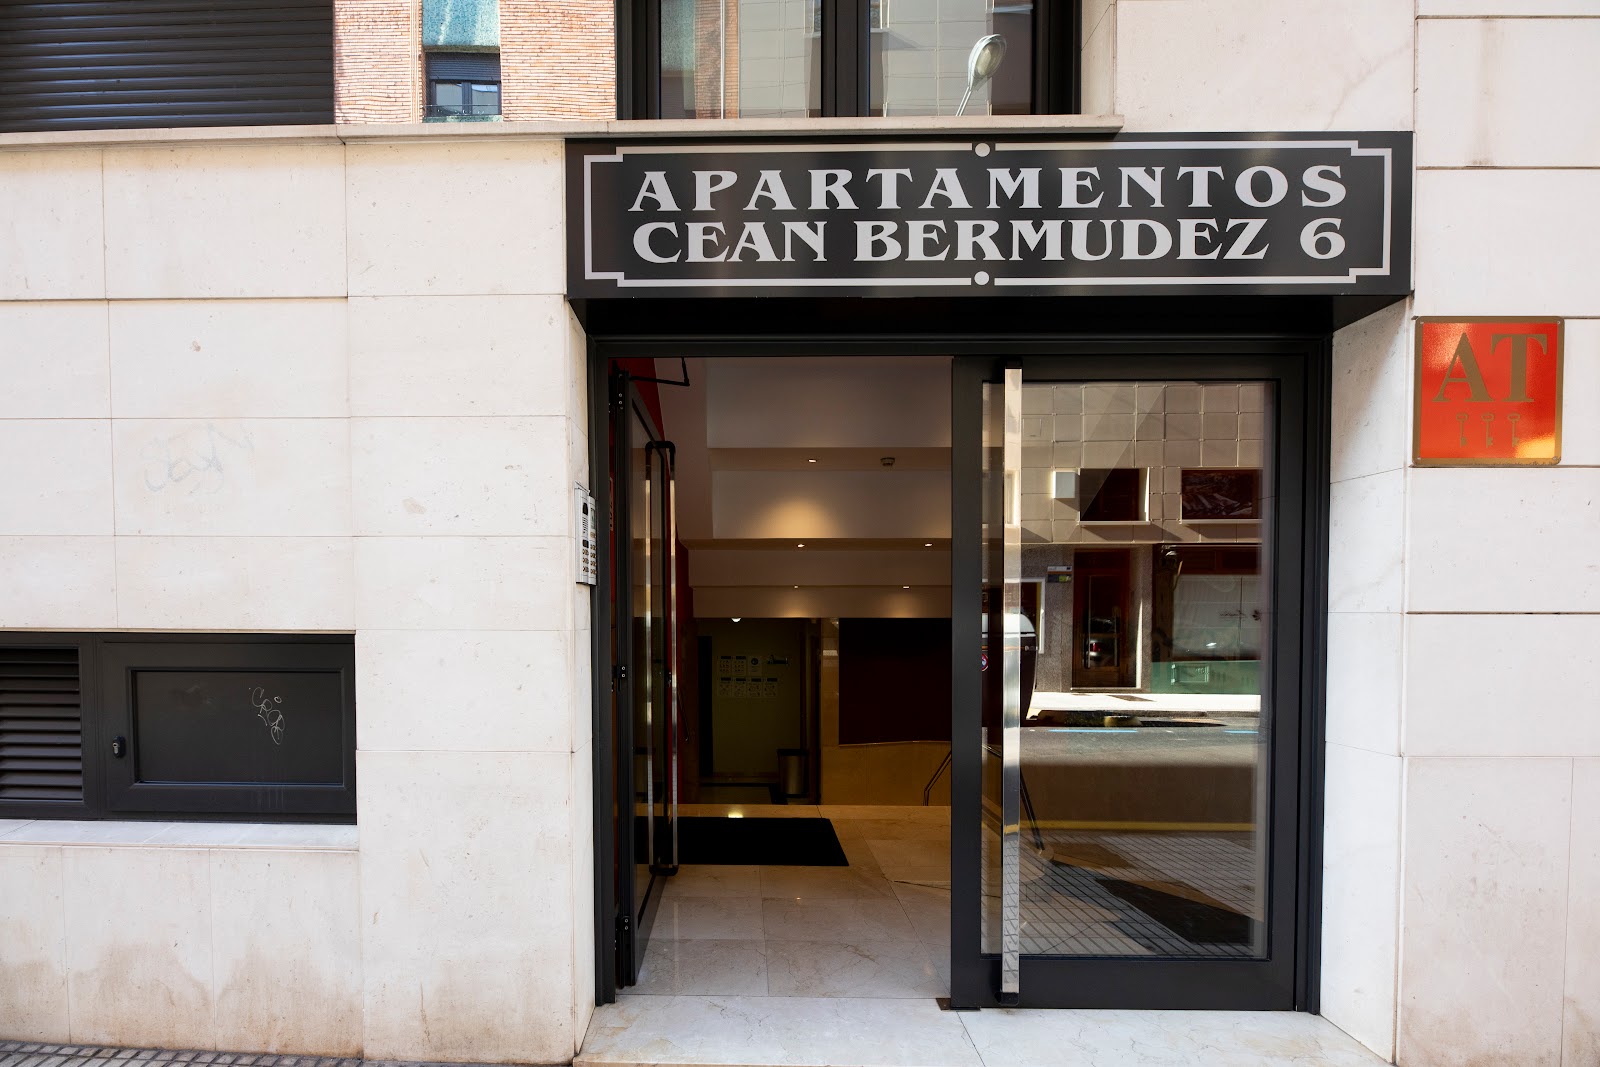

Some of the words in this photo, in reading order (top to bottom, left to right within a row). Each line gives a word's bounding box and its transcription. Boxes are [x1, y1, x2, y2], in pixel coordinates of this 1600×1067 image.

[628, 165, 1347, 212] APARTAMENTOS
[633, 220, 827, 263] CEAN
[854, 218, 1270, 262] BERMUDEZ
[1299, 217, 1346, 260] 6
[1432, 332, 1548, 403] AT
